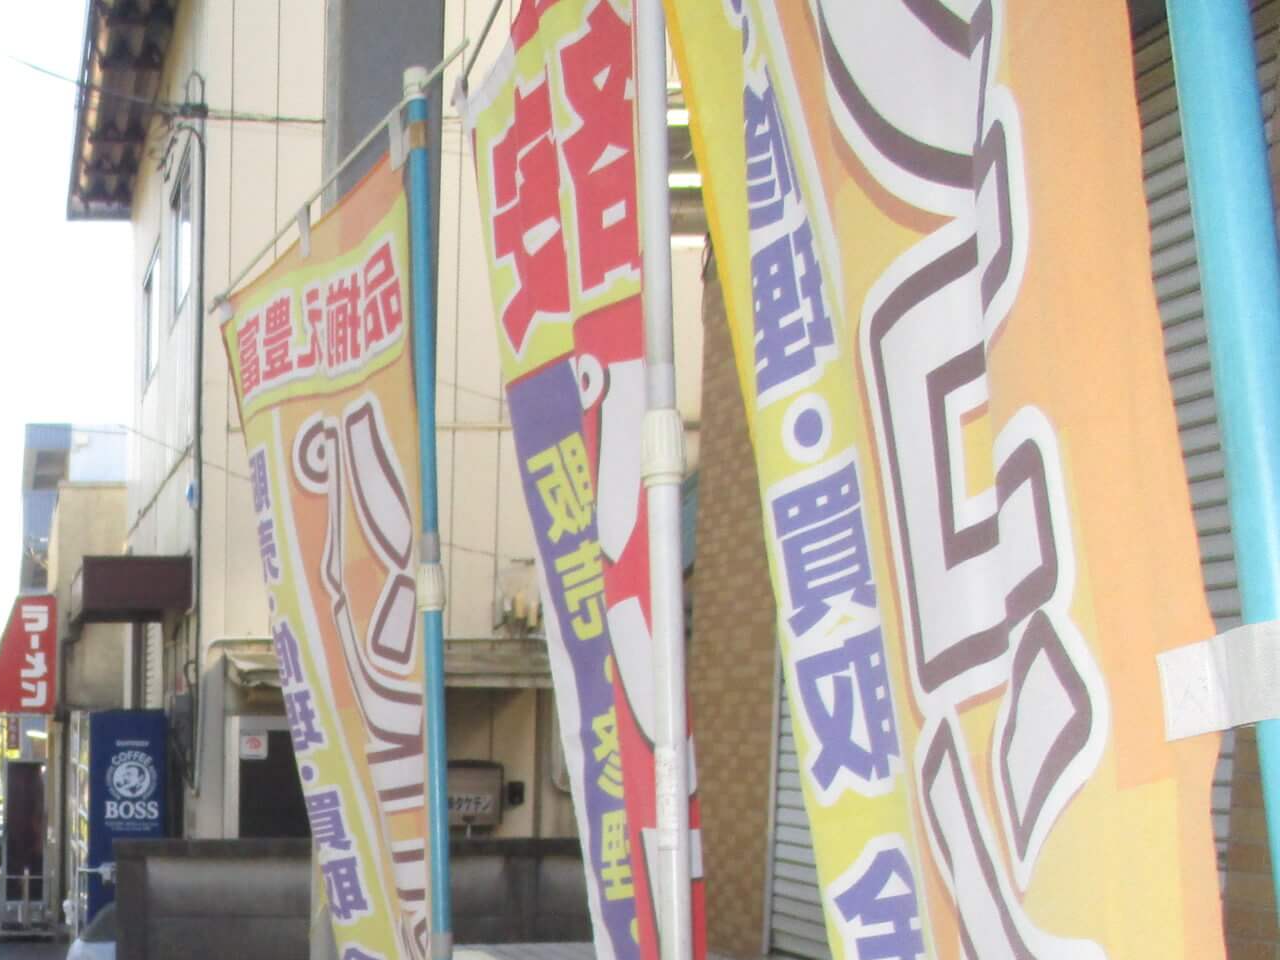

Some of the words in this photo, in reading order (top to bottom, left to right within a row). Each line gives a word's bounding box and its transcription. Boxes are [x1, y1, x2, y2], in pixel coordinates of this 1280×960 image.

[20, 604, 49, 708] ラーメン
[111, 750, 153, 767] COFFEE
[104, 800, 160, 820] BOSS
